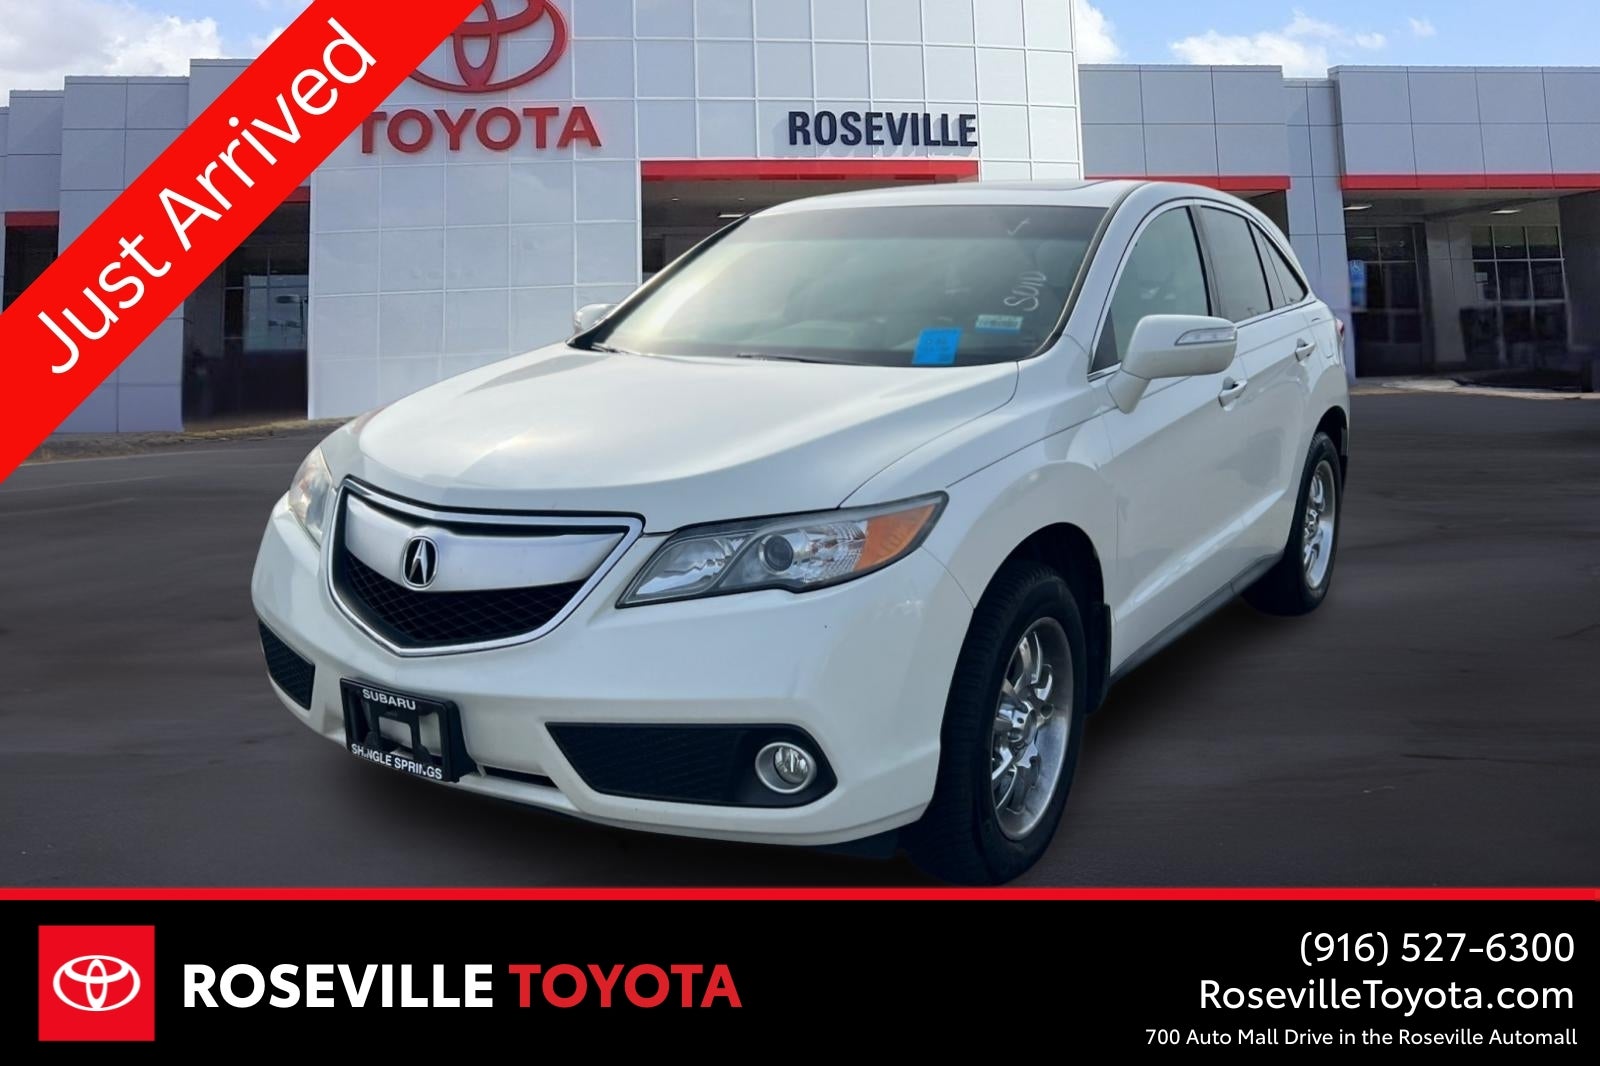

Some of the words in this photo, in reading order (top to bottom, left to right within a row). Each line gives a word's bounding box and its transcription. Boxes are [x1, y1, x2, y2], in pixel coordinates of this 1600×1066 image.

[361, 106, 602, 154] TOYOTA
[788, 111, 978, 147] ROSEVILLE
[362, 688, 416, 711] SUBARU
